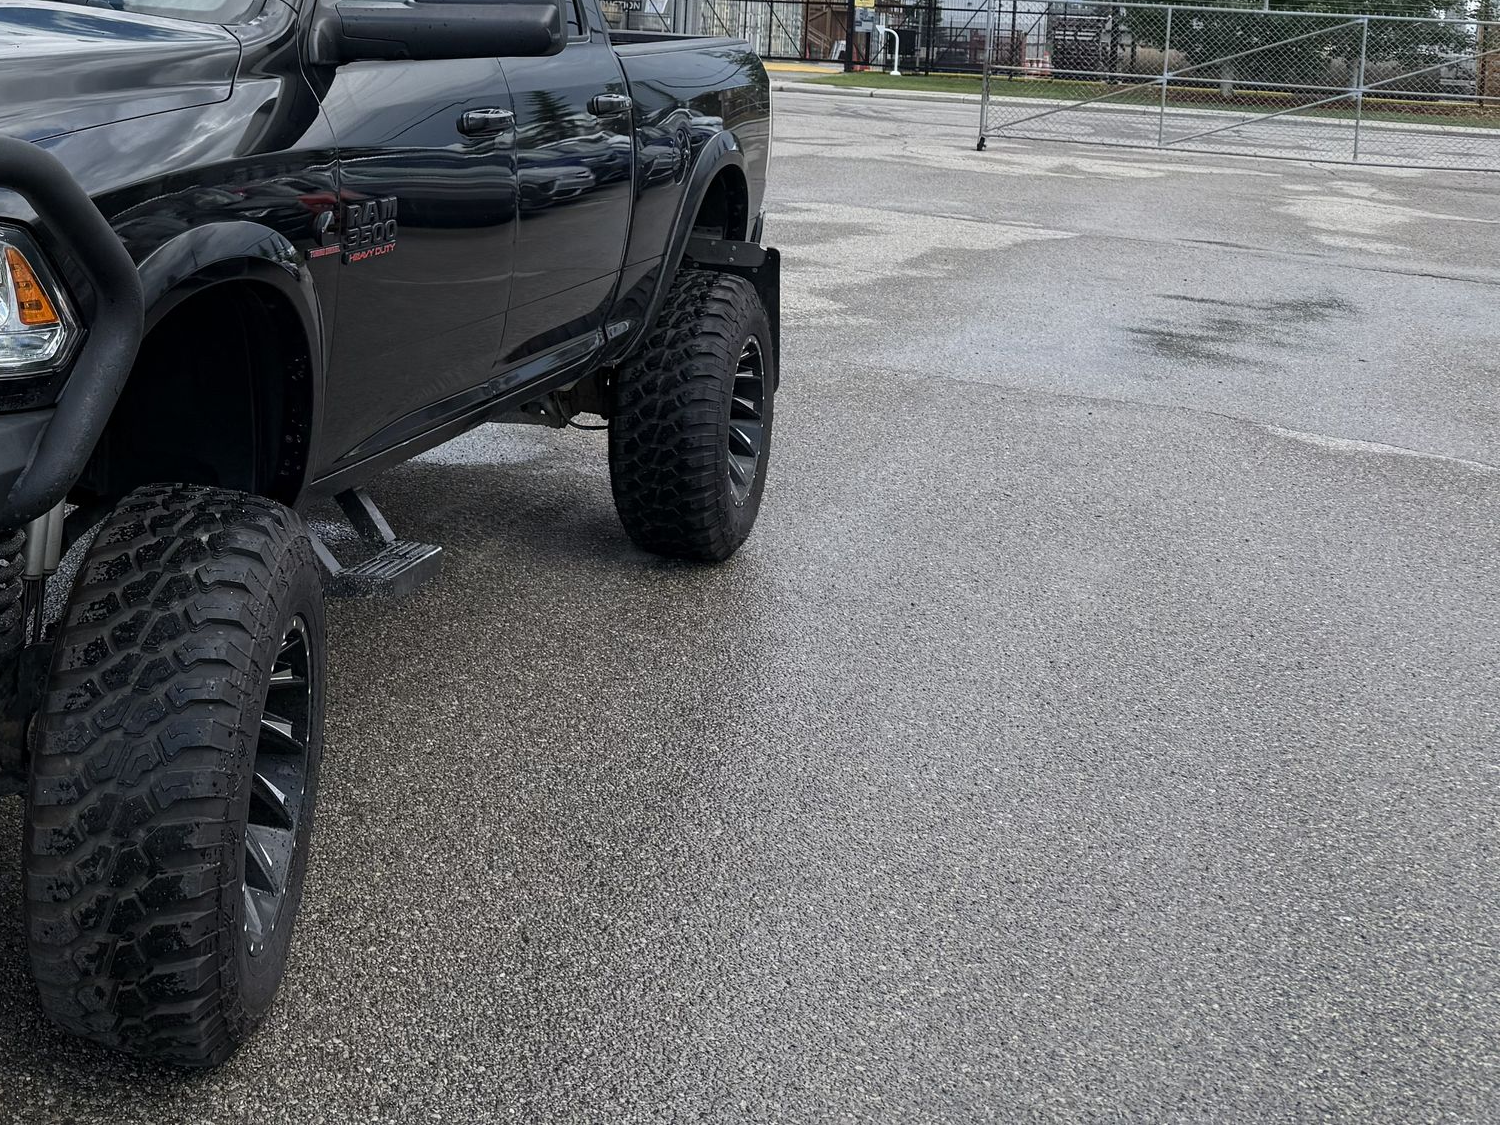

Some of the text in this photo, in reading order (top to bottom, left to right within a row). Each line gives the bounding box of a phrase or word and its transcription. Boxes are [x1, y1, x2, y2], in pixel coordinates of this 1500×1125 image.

[347, 196, 398, 228] RAM
[347, 219, 398, 246] 3500
[349, 249, 375, 263] HEAVY
[375, 242, 396, 256] DUTY
